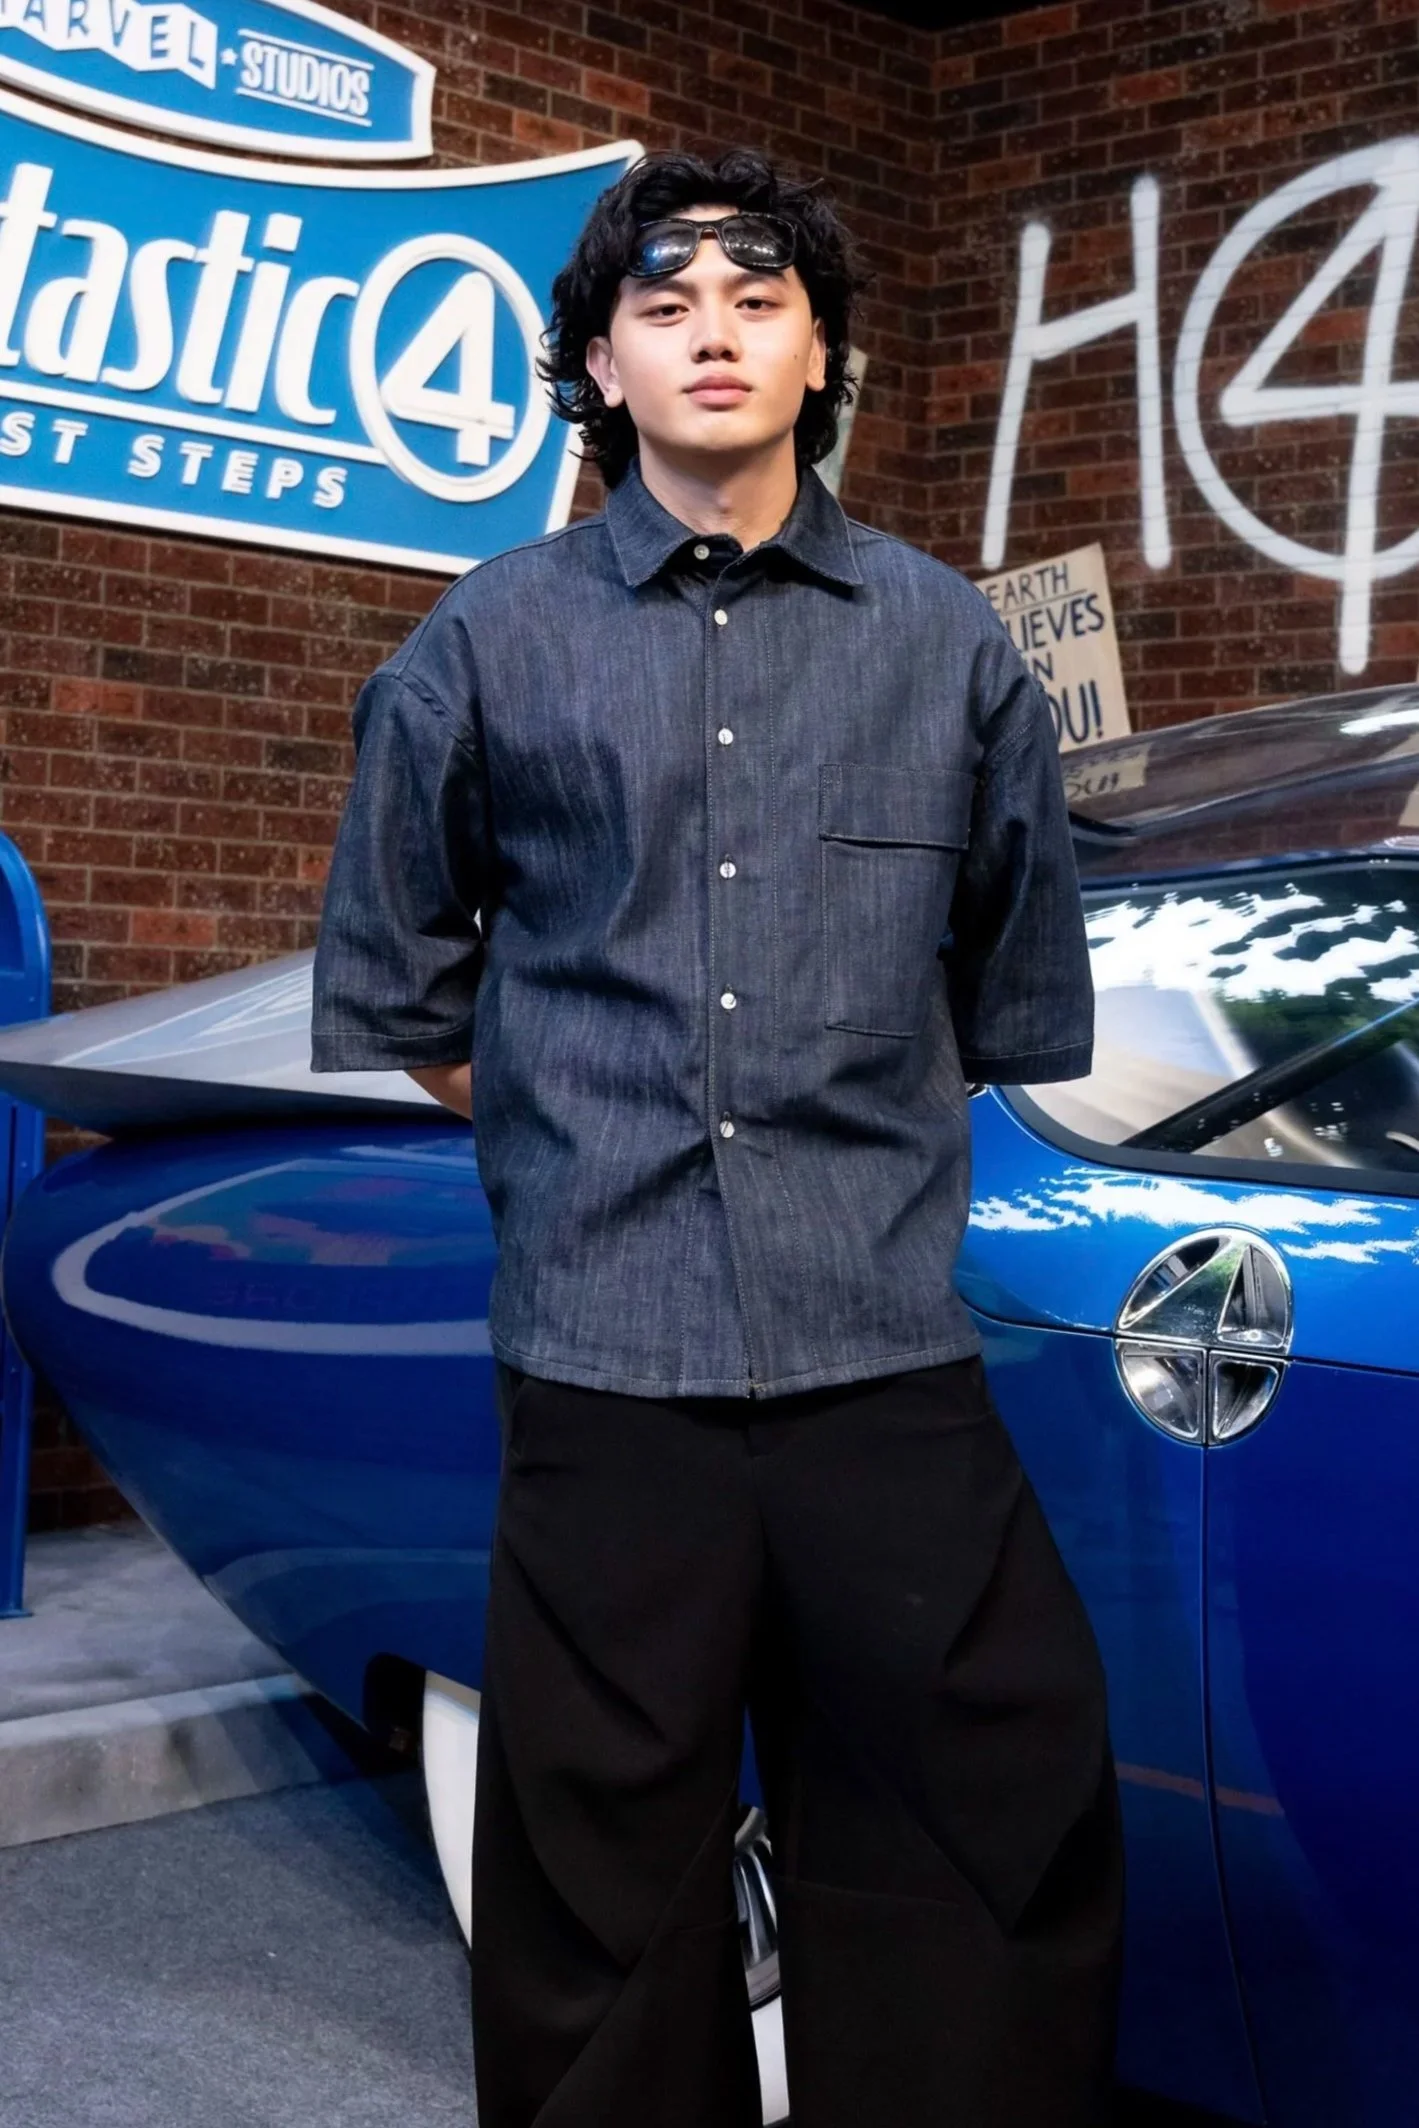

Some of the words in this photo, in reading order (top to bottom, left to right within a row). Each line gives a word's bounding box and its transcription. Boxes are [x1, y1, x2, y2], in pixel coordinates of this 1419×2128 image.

[0, 0, 206, 71] ARVEL
[241, 41, 370, 117] STUDIOS
[0, 411, 88, 465] ST
[127, 434, 349, 509] STEPS
[986, 561, 1069, 612] EARTH
